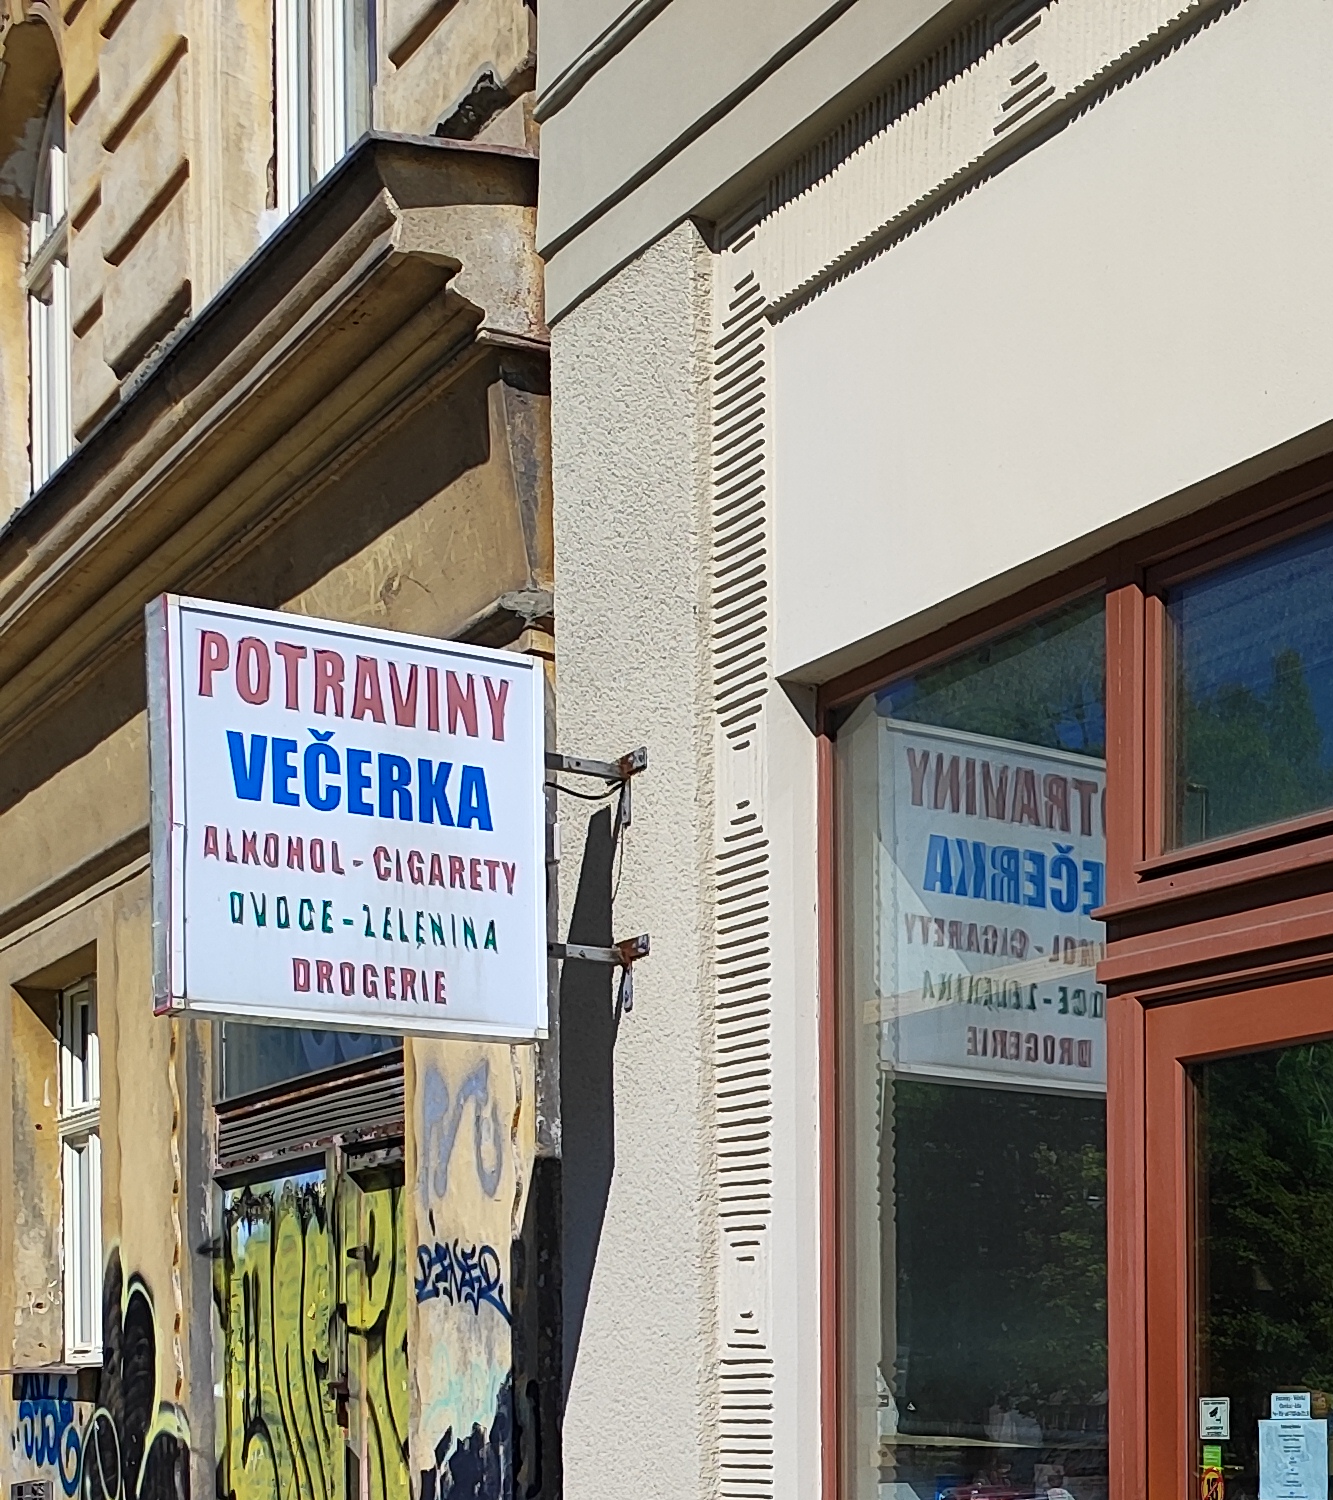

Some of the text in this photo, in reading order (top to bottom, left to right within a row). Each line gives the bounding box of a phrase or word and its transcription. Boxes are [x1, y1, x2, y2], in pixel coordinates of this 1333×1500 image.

[197, 629, 513, 742] POTRAVINY
[226, 728, 493, 831] VEČERKA
[293, 958, 447, 1005] DROGERIE
